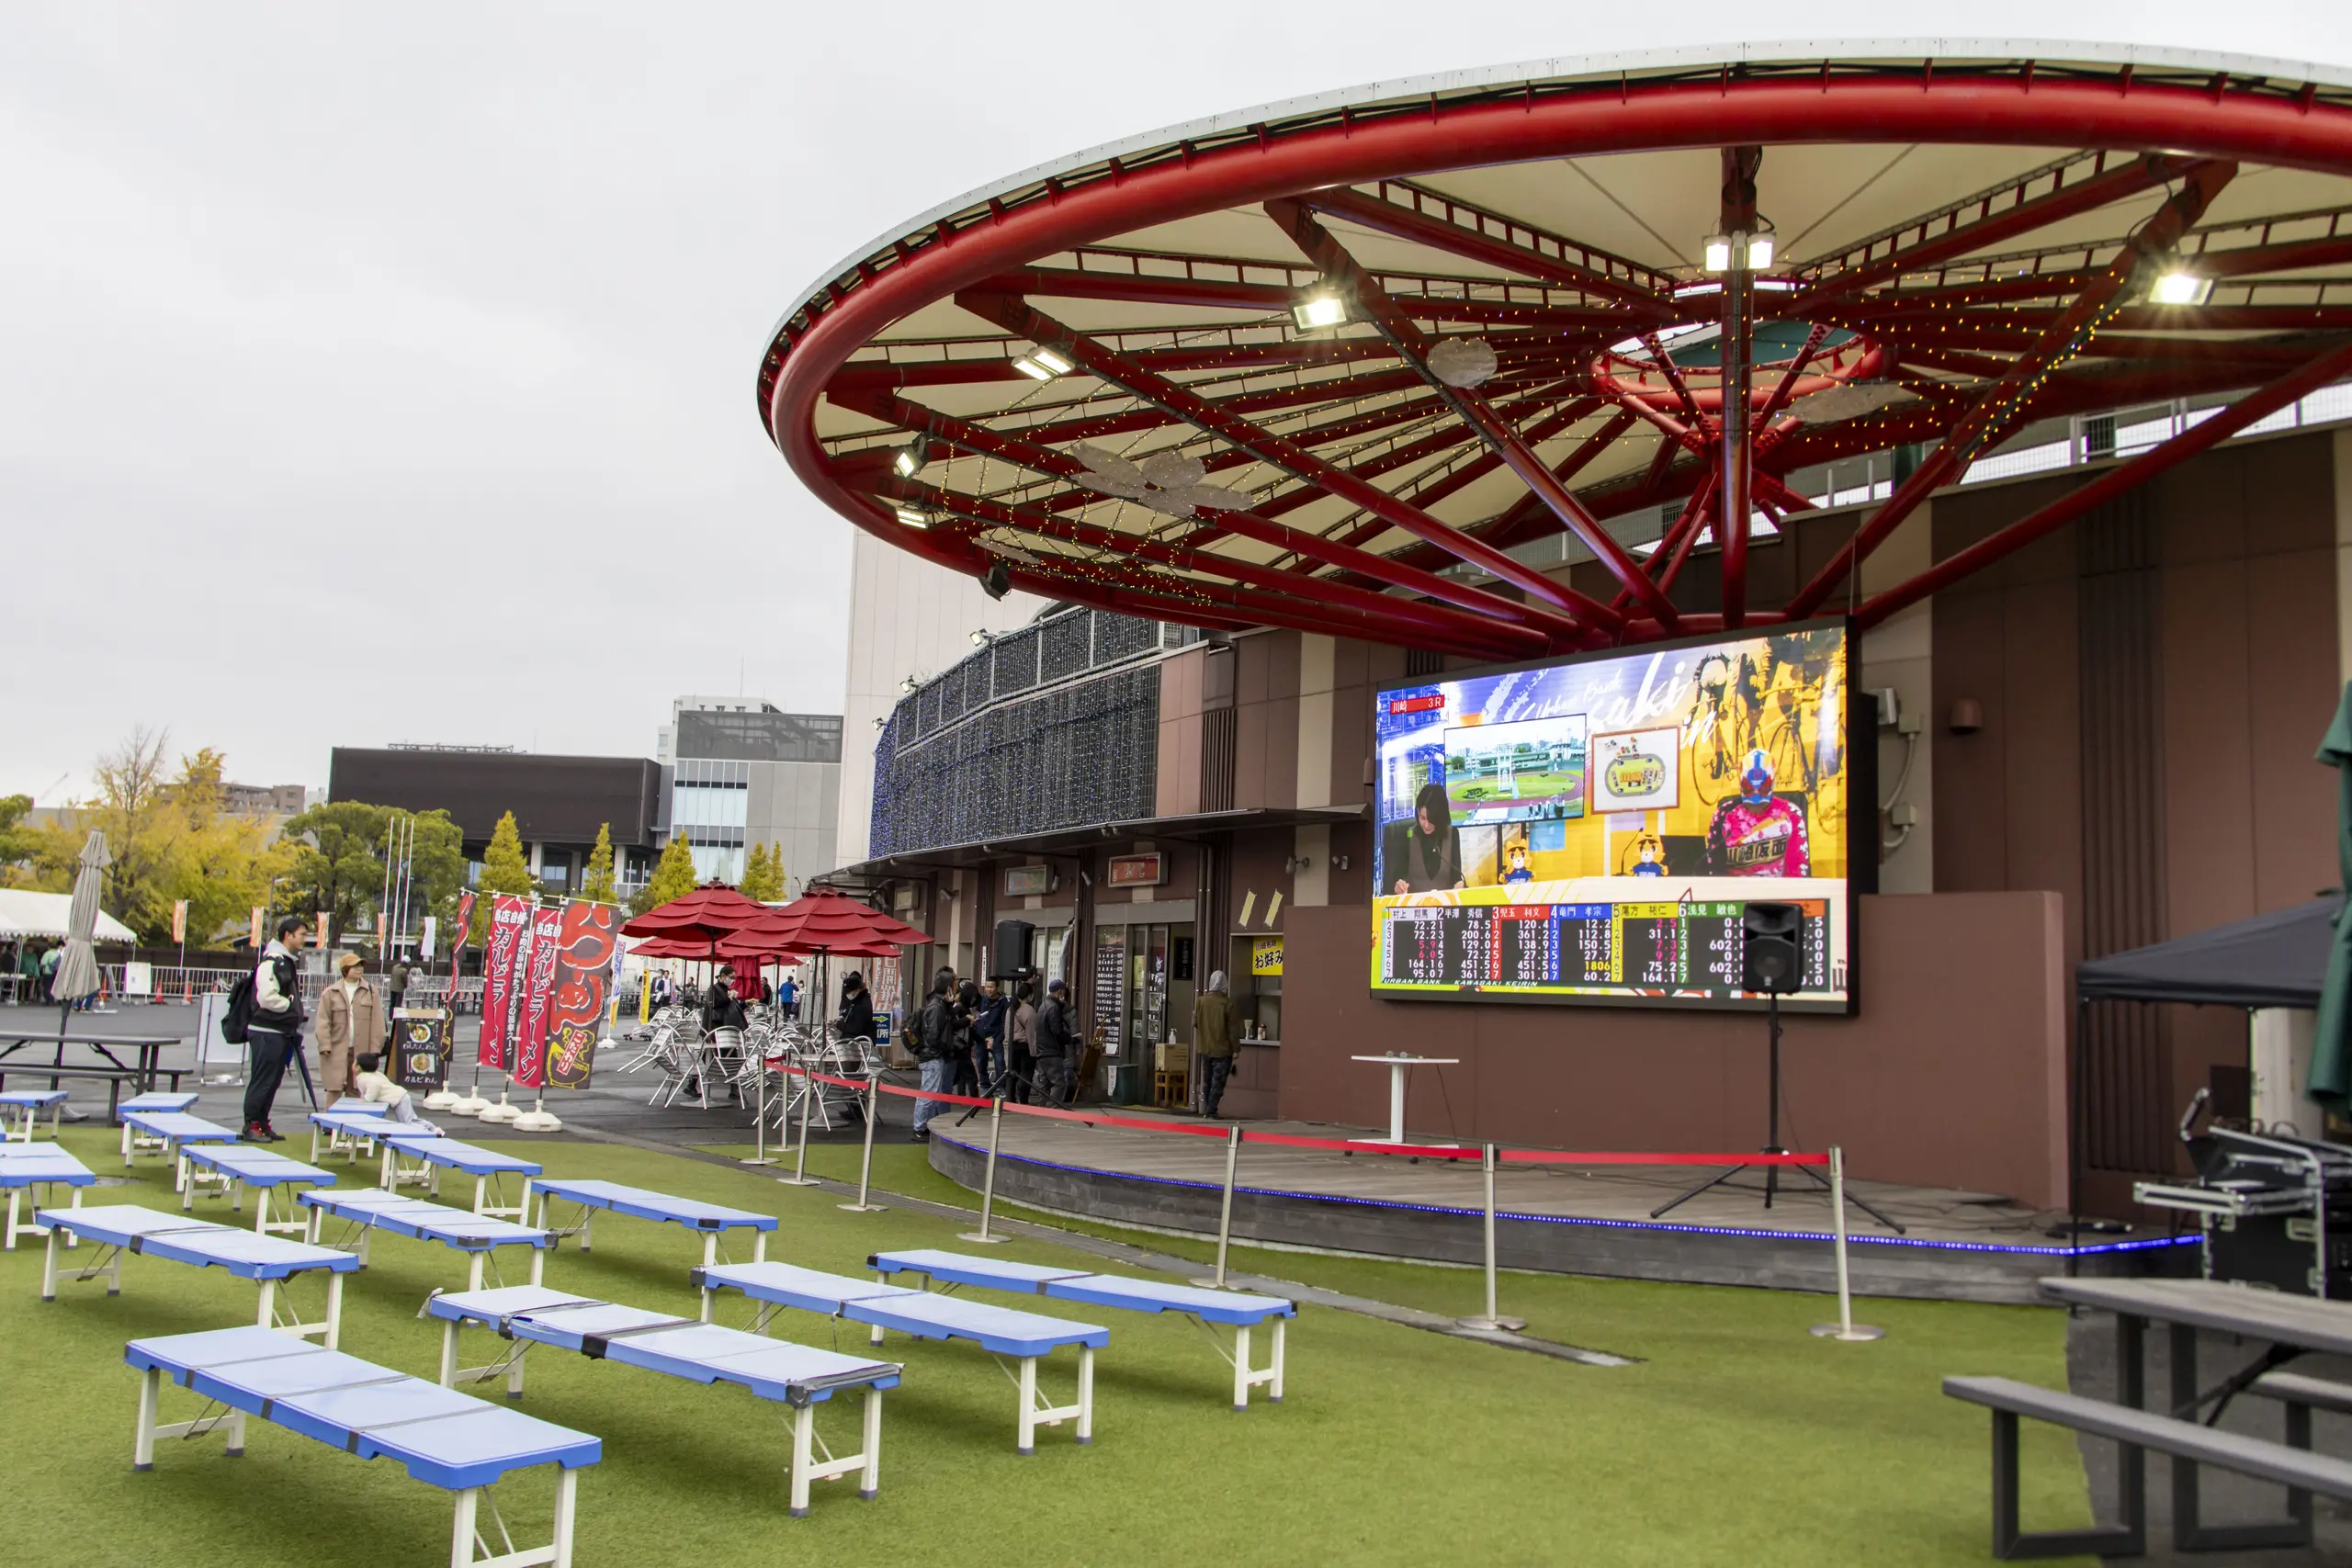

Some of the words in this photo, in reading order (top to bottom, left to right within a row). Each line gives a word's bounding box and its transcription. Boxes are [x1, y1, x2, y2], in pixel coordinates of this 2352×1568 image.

[1393, 701, 1408, 713] 川崎
[1428, 696, 1442, 707] 3R
[1393, 909, 1407, 919] 村上
[1438, 908, 1443, 919] 2
[1467, 908, 1483, 918] 秀信
[1493, 907, 1498, 919] 3
[1524, 908, 1540, 917] 利文
[1551, 906, 1557, 918] 4
[1613, 905, 1619, 917] 5
[1679, 903, 1686, 917] 6
[1688, 905, 1707, 915] 浅見
[494, 908, 528, 925] 当店自慢
[1415, 920, 1435, 930] 72.2
[1468, 920, 1490, 929] 78.5
[1519, 920, 1548, 929] 120.4
[1586, 919, 1611, 928] 12.2
[1657, 919, 1677, 928] 2.5
[536, 921, 562, 937] 当店自
[1414, 931, 1435, 939] 72.2
[1439, 931, 1443, 939] 3
[1462, 931, 1490, 939] 200.6
[1494, 931, 1498, 939] 2
[1518, 931, 1549, 939] 361.2
[1553, 931, 1557, 939] 2
[1579, 930, 1611, 939] 112.8
[1649, 930, 1676, 939] 31.1
[1680, 930, 1687, 939] 2
[1439, 941, 1443, 949] 4
[1463, 941, 1490, 949] 129.0
[1494, 941, 1498, 949] 4
[1519, 941, 1549, 949] 138.9
[1553, 941, 1557, 949] 3
[1579, 941, 1611, 949] 150.5
[1657, 941, 1677, 950] 7.3
[1680, 941, 1687, 950] 3
[1419, 950, 1435, 958] 6.0
[1438, 950, 1443, 958] 5
[1467, 950, 1490, 959] 72.2
[1493, 951, 1498, 959] 5
[1524, 951, 1548, 959] 27.3
[1552, 951, 1557, 959] 5
[1585, 951, 1611, 960] 27.7
[1656, 952, 1677, 961] 9.2
[1680, 952, 1687, 961] 4
[1438, 960, 1443, 968] 6
[1461, 960, 1490, 969] 451.5
[1493, 961, 1498, 969] 6
[1518, 961, 1548, 970] 451.5
[1552, 961, 1557, 969] 6
[1585, 961, 1610, 971] 1806
[1649, 962, 1677, 972] 75.2
[1680, 963, 1687, 972] 5
[1413, 969, 1435, 977] 95.0
[1461, 970, 1489, 979] 361.2
[1494, 971, 1498, 979] 7
[1518, 971, 1548, 980] 301.0
[1553, 971, 1557, 980] 7
[1584, 972, 1610, 981] 60.2
[1643, 972, 1675, 982] 164.1
[1681, 974, 1687, 983] 7
[521, 941, 554, 1082] カルビラーメン
